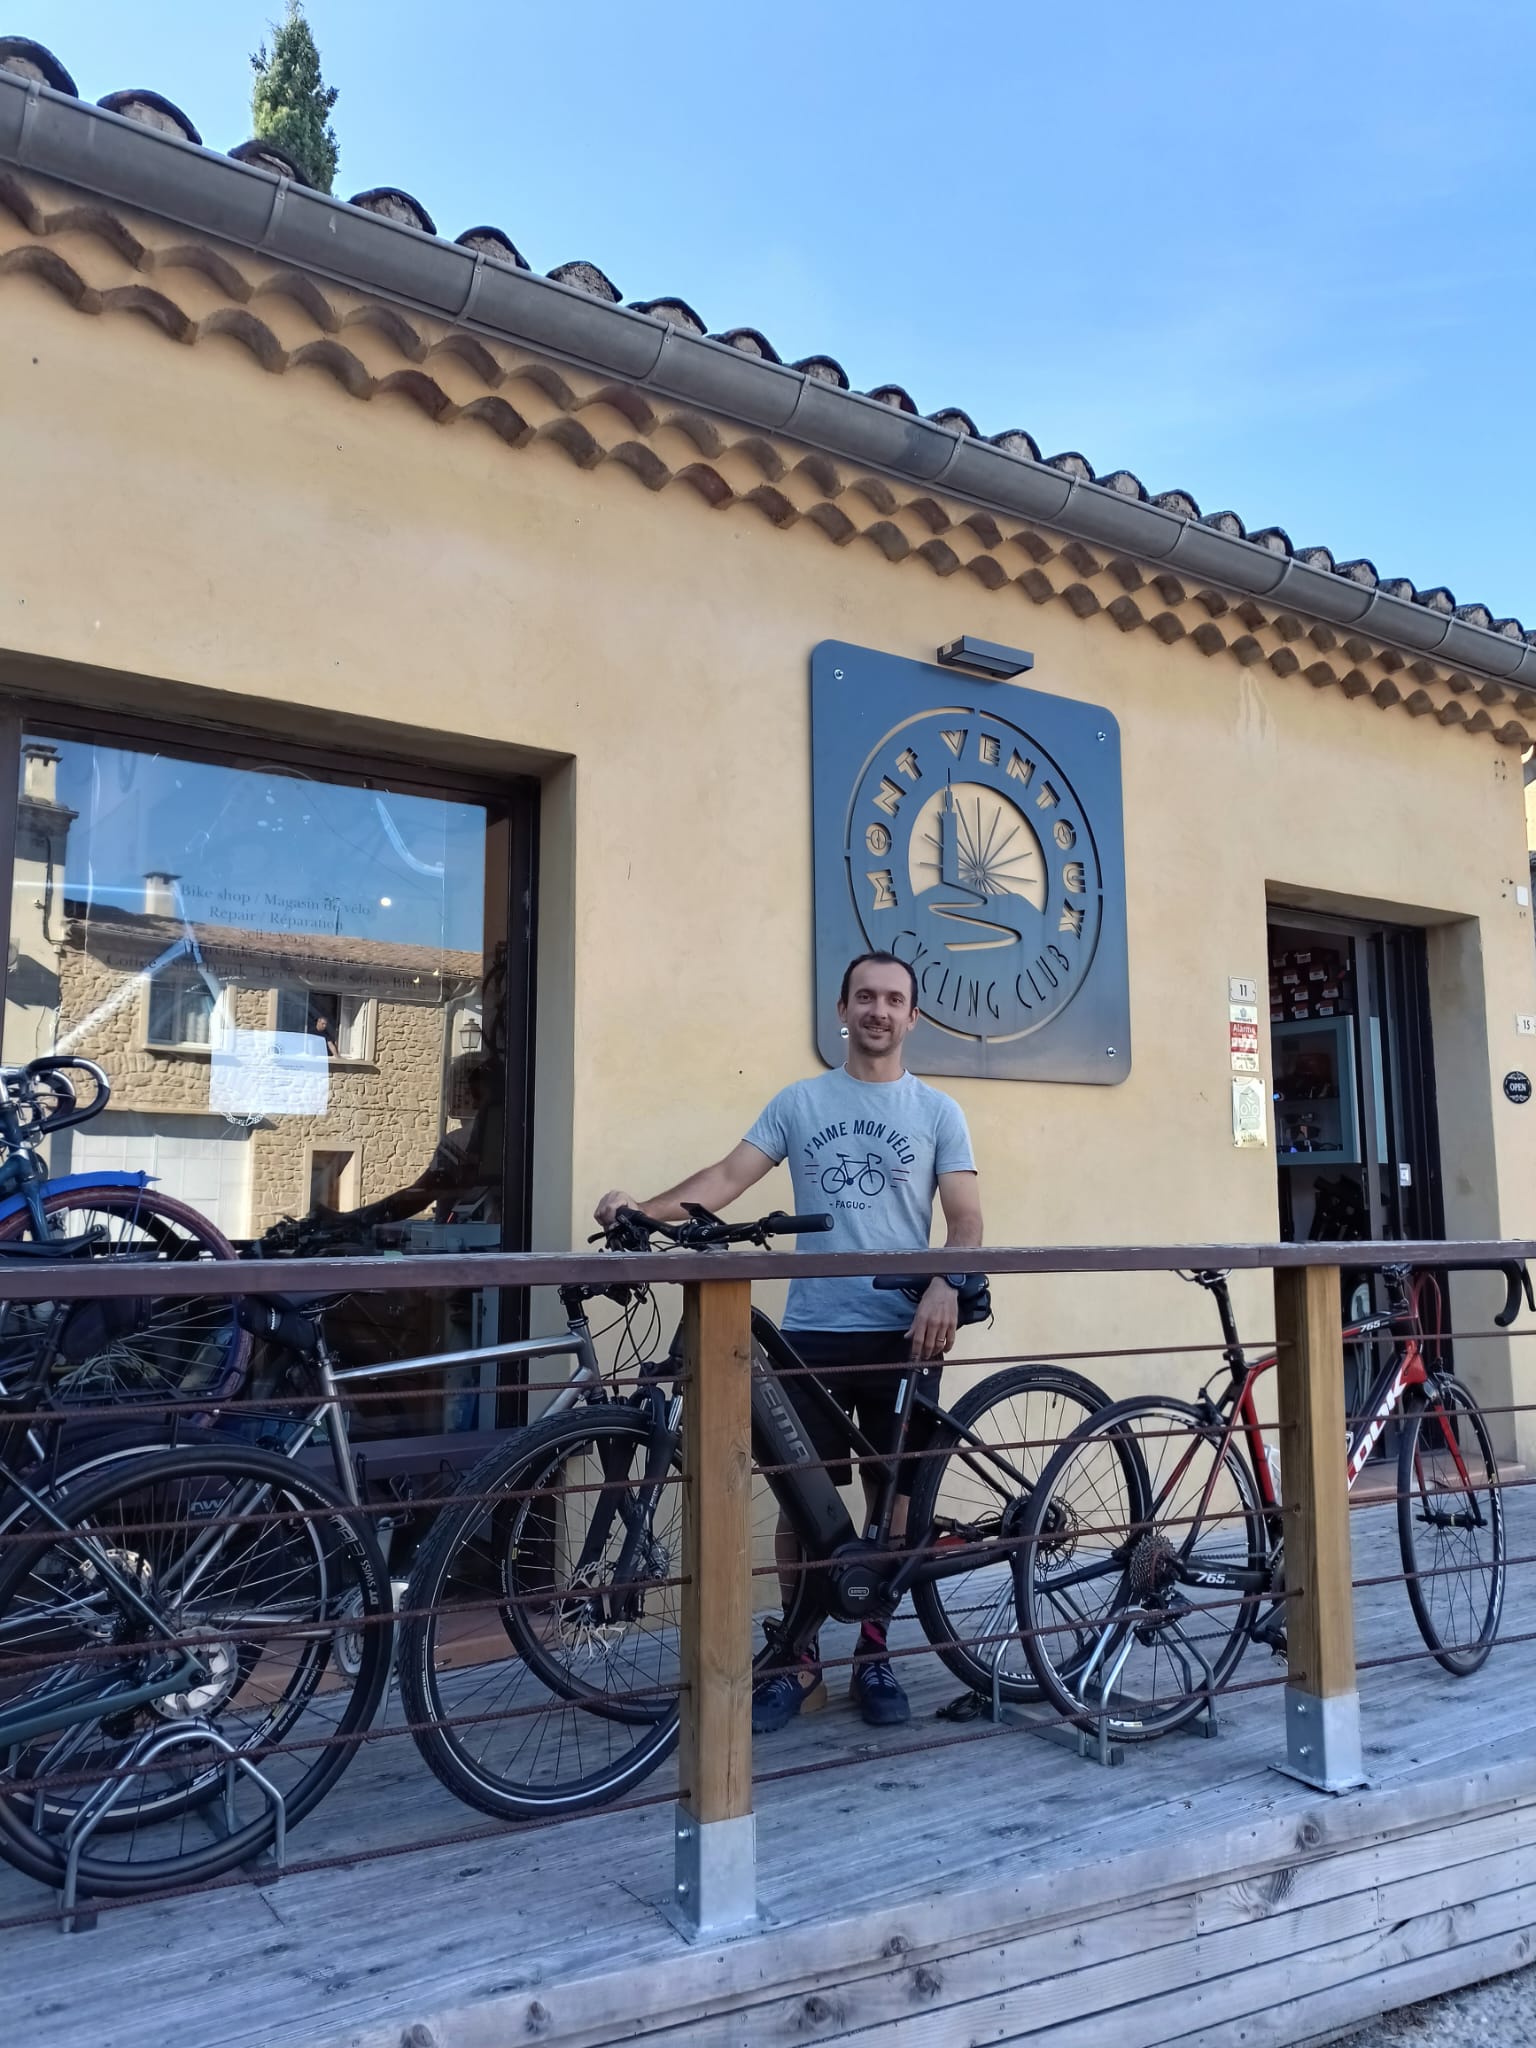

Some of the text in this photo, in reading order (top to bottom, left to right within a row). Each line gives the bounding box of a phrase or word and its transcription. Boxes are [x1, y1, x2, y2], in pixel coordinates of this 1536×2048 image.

[865, 729, 1087, 940] MONT VENTOUX
[182, 883, 213, 899] Bike
[218, 887, 251, 906] shop
[264, 893, 319, 912] Magasin
[209, 905, 256, 923] Repair
[270, 911, 344, 930] Réparation
[891, 930, 1070, 1019] CYCLING CLUB
[1239, 983, 1248, 997] 11
[1523, 1019, 1531, 1030] 15
[1509, 1082, 1527, 1092] OPEN
[803, 1119, 916, 1165] J'AIME MON VÉLO
[835, 1200, 866, 1210] FAGUO
[1360, 1319, 1381, 1333] 765
[1347, 1367, 1408, 1492] LOOK
[360, 1559, 379, 1606] DT SWISS
[1195, 1571, 1226, 1584] 765
